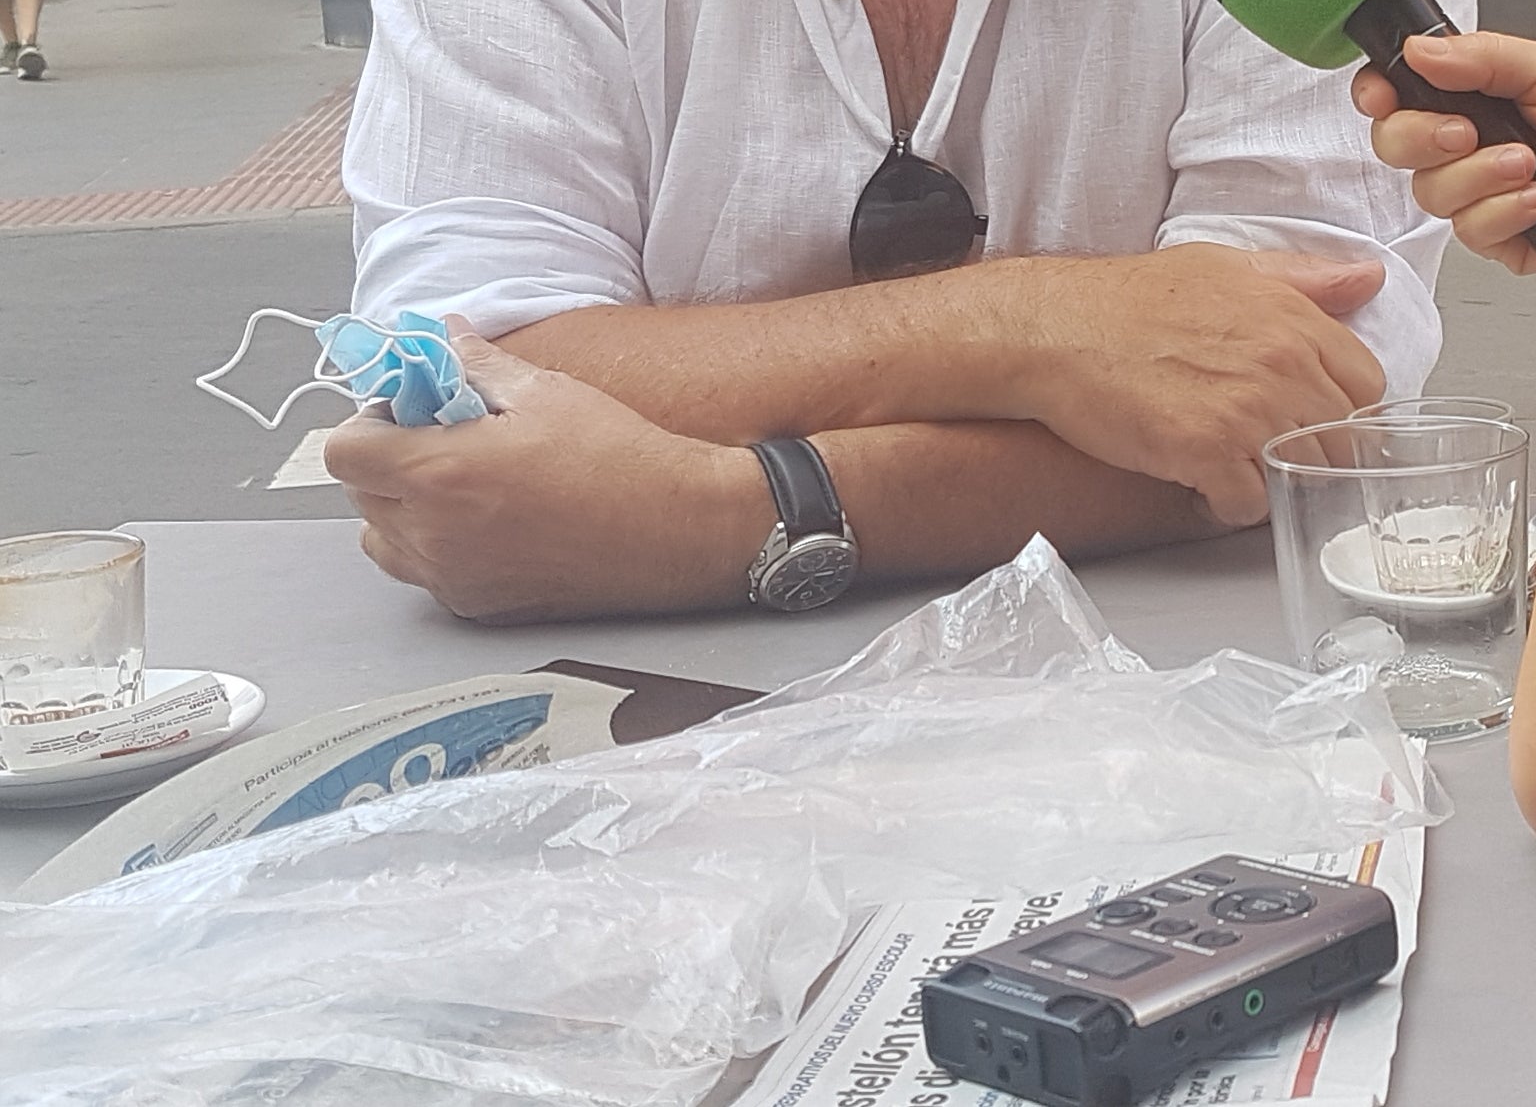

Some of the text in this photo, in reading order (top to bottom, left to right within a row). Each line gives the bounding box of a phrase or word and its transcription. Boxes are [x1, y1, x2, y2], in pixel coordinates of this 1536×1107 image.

[244, 749, 312, 792] Participa
[316, 740, 329, 752] al
[875, 932, 912, 973] ESCOLAR
[885, 955, 962, 1029] terá
[943, 907, 995, 950] más
[854, 972, 888, 1006] CURSO
[832, 1004, 868, 1035] NUEVO
[819, 1034, 846, 1052] DEL
